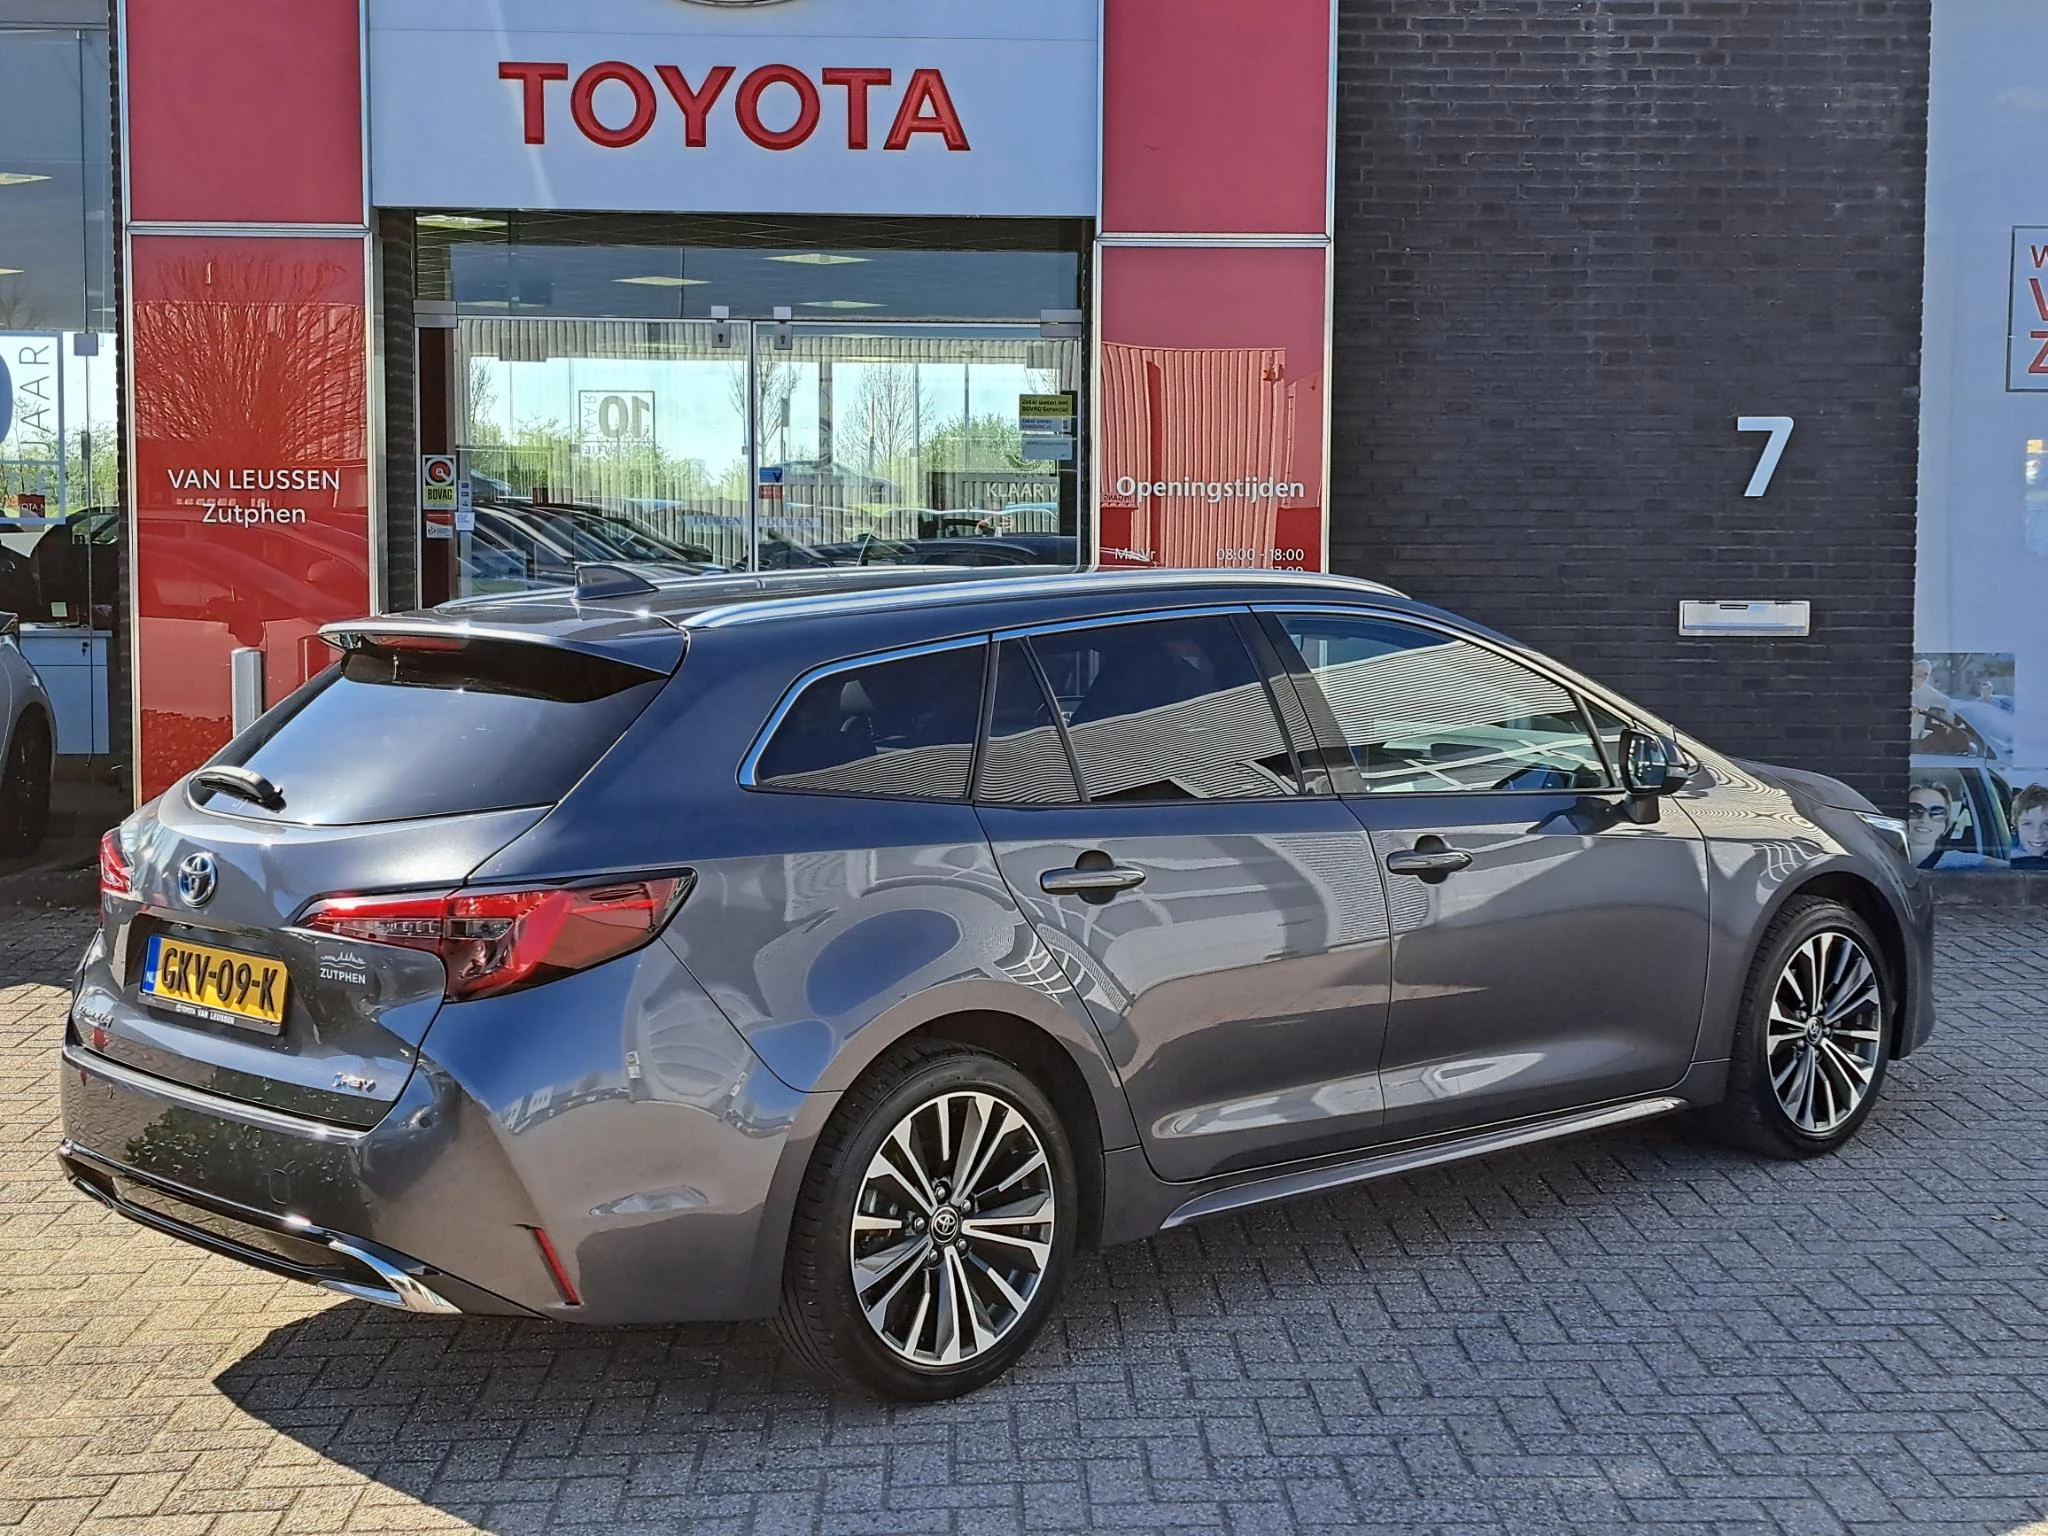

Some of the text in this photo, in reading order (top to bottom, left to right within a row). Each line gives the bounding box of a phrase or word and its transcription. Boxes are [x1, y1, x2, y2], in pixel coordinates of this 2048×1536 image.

[498, 60, 970, 151] TOYOTA
[18, 345, 50, 453] JAAR
[1737, 416, 1794, 497] 7
[168, 469, 340, 490] VAN LEUSSEN
[986, 482, 1044, 498] KLAAR
[1116, 475, 1304, 503] Openingstijden
[427, 488, 453, 501] BOVAG
[202, 502, 306, 528] Zutphen
[1216, 548, 1256, 561] 08:00
[1270, 549, 1305, 561] 18:00
[162, 947, 279, 1012] GKV-09-K
[319, 967, 367, 985] ZUTPHEN
